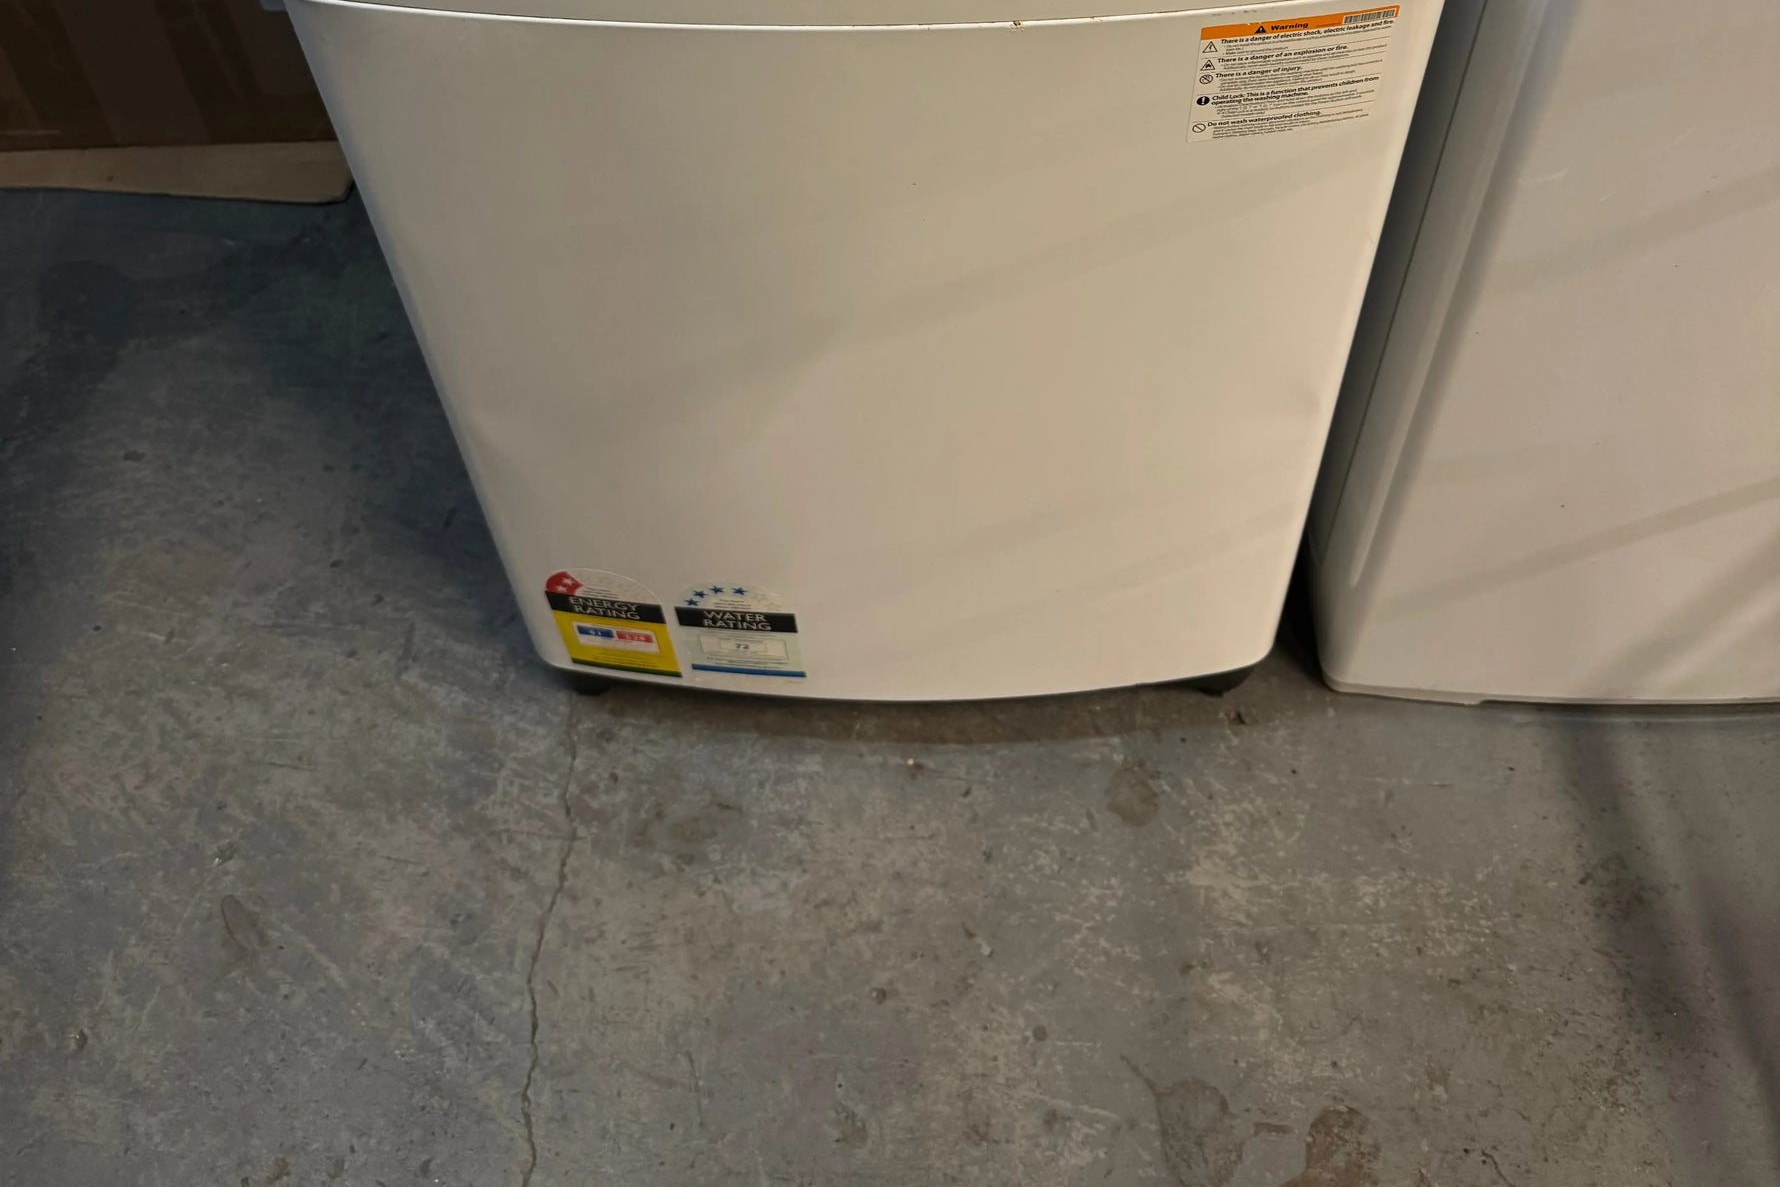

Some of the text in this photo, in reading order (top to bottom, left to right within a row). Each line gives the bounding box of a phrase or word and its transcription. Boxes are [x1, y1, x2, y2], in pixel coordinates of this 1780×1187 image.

[1221, 37, 1239, 45] There
[1249, 34, 1272, 44] danger
[1272, 33, 1280, 41] of
[1280, 30, 1304, 39] electric
[1303, 28, 1323, 36] shock,
[1323, 25, 1346, 34] electric
[1346, 22, 1370, 32] leakage
[1371, 20, 1383, 28] and
[1383, 18, 1395, 26] fire.
[1270, 21, 1309, 32] Warning
[1249, 53, 1274, 63] danger
[1275, 51, 1283, 59] of
[1293, 47, 1326, 57] explosion
[1335, 44, 1348, 52] fire.
[1248, 68, 1271, 77] danger
[1280, 65, 1303, 74] injury.
[1271, 87, 1297, 96] function
[1297, 85, 1311, 93] that
[1310, 82, 1338, 92] prevents
[1338, 77, 1364, 87] children
[1364, 75, 1380, 83] from
[1211, 97, 1242, 107] operating
[1254, 93, 1280, 103] washing
[1280, 91, 1309, 99] machine.
[1248, 113, 1293, 124] waterproofed
[1294, 110, 1322, 118] clothing.
[569, 595, 639, 612] ENERGY
[574, 605, 641, 620] RATING
[703, 610, 768, 623] WATER
[703, 618, 773, 632] RATING
